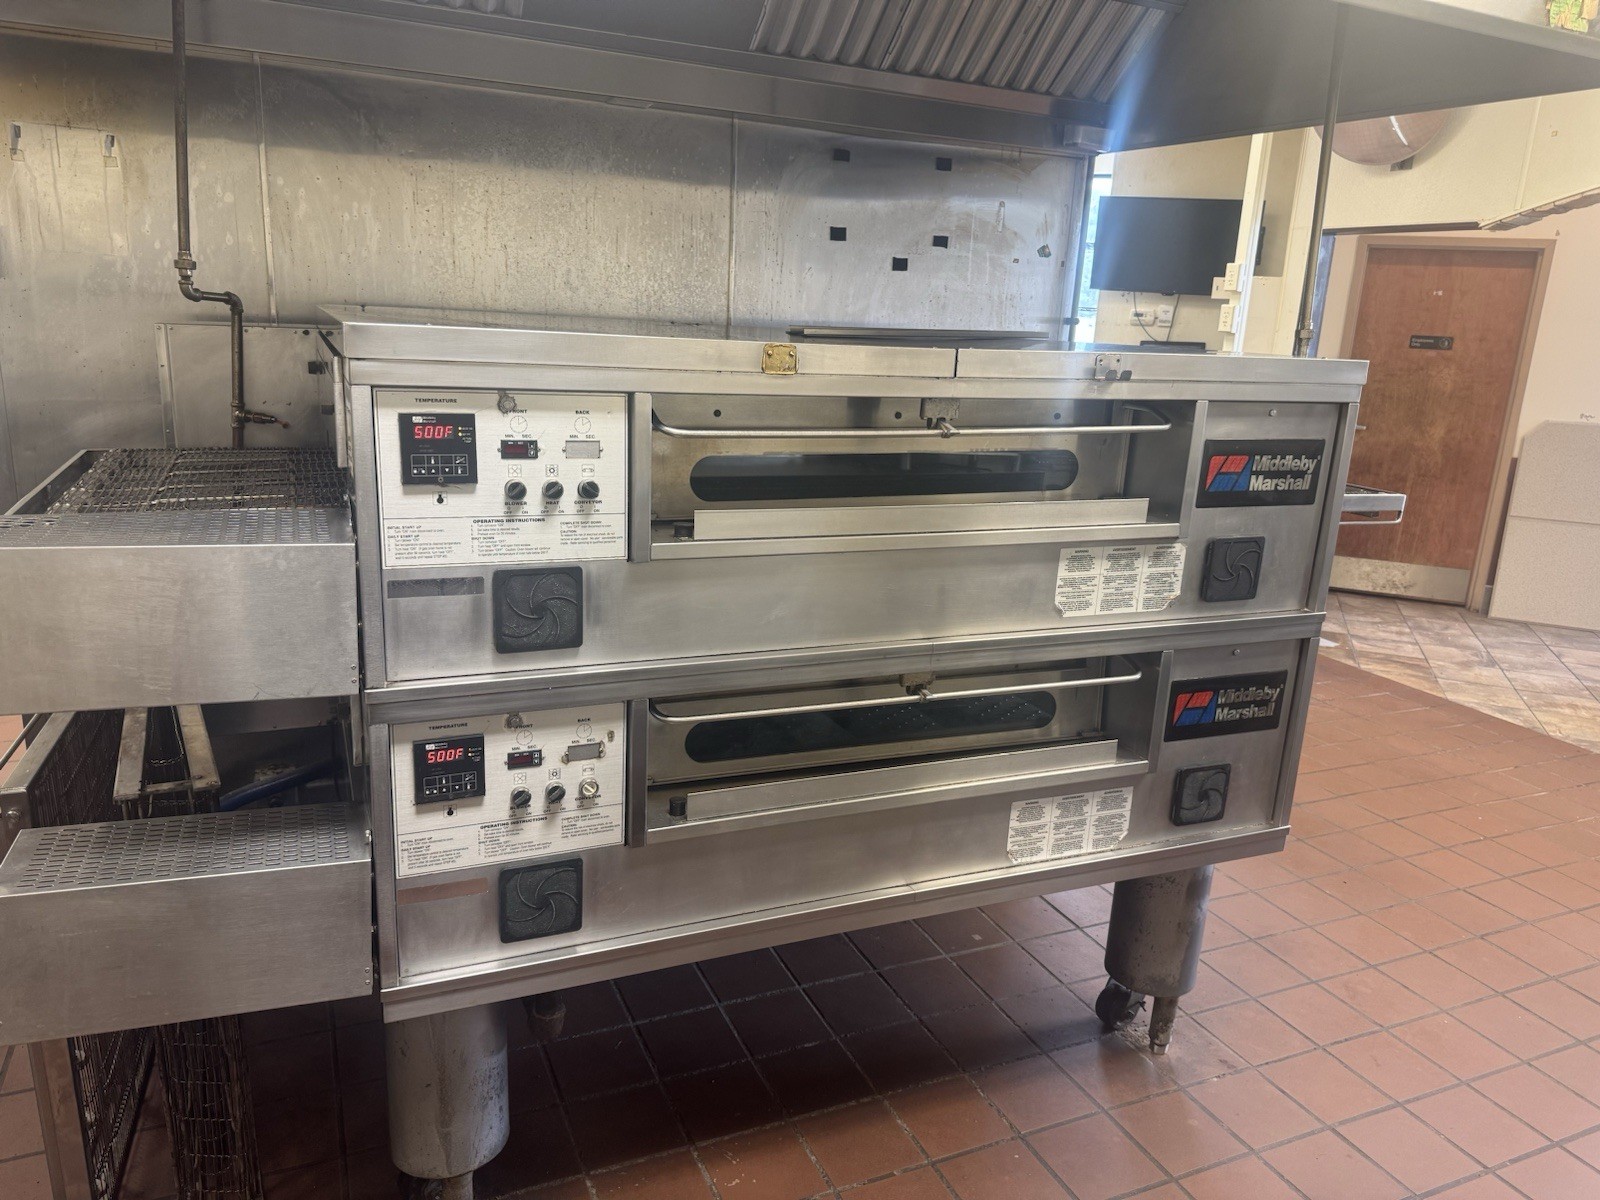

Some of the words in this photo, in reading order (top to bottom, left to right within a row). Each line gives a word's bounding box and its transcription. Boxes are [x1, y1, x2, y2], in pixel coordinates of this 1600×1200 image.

[414, 426, 453, 438] 500F
[1252, 455, 1318, 473] Middleby
[1249, 474, 1312, 491] Marshall
[1218, 686, 1280, 704] Middleby
[1215, 702, 1276, 722] Marshall
[428, 748, 463, 763] 500F
[511, 817, 548, 825] INSTRUCTIONS
